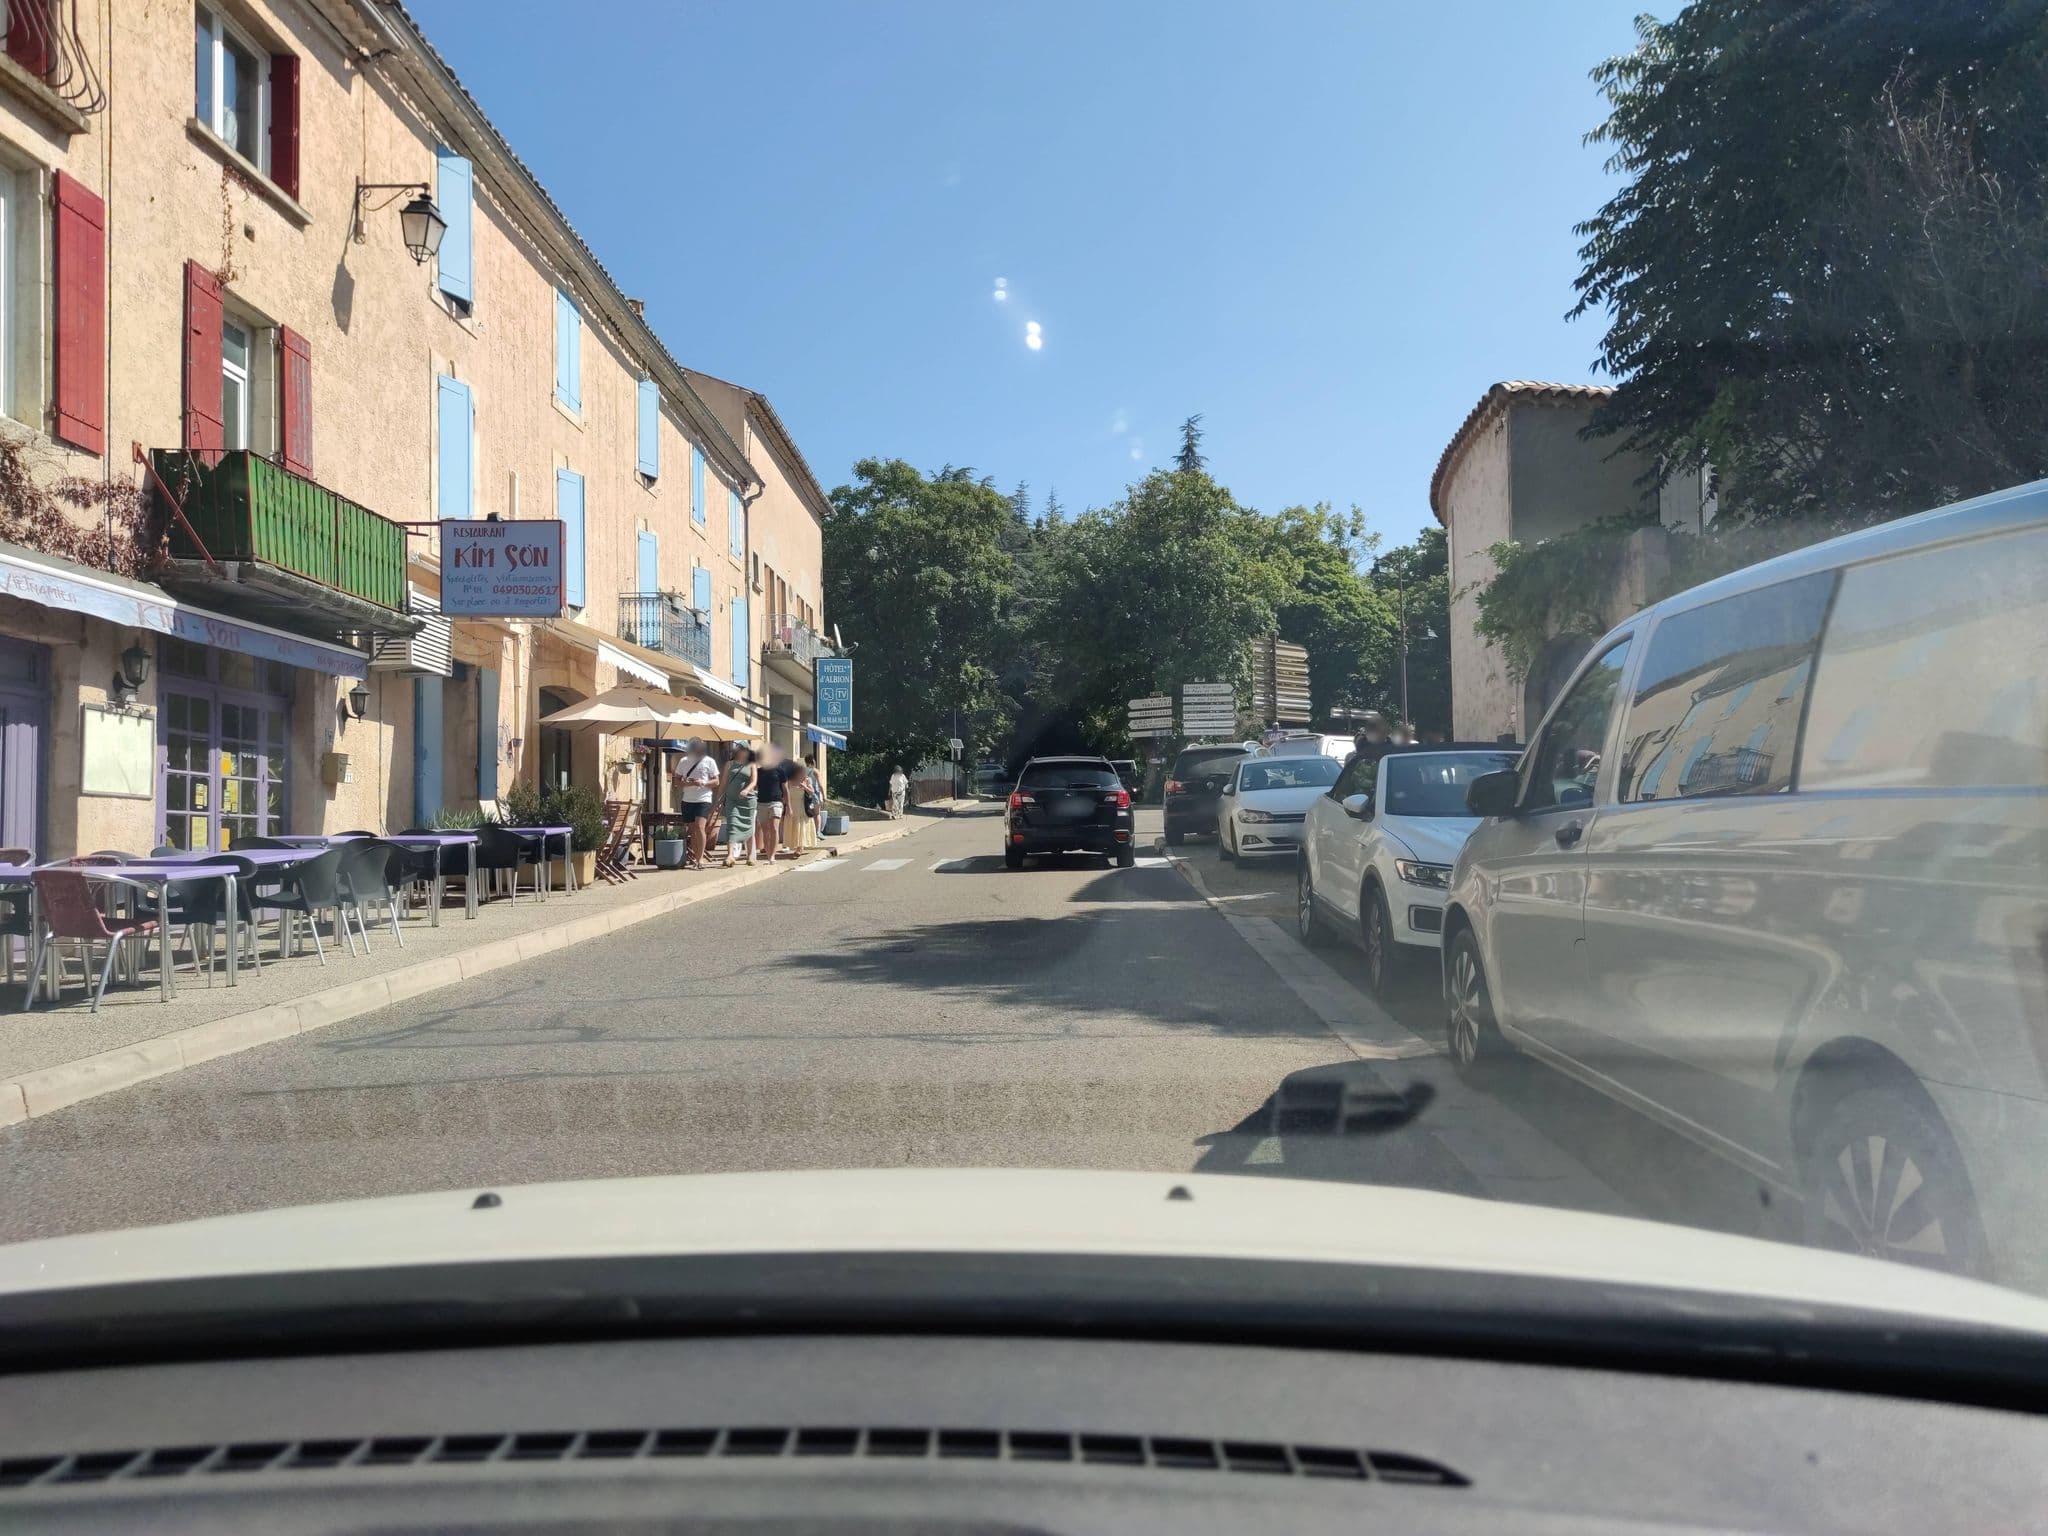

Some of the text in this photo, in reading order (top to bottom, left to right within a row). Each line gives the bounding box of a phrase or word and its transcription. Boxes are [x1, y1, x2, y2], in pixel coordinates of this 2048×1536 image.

[453, 527, 506, 538] RESTAURANT
[454, 541, 495, 568] KIM
[820, 675, 850, 683] d'ALBION
[838, 690, 847, 699] TV
